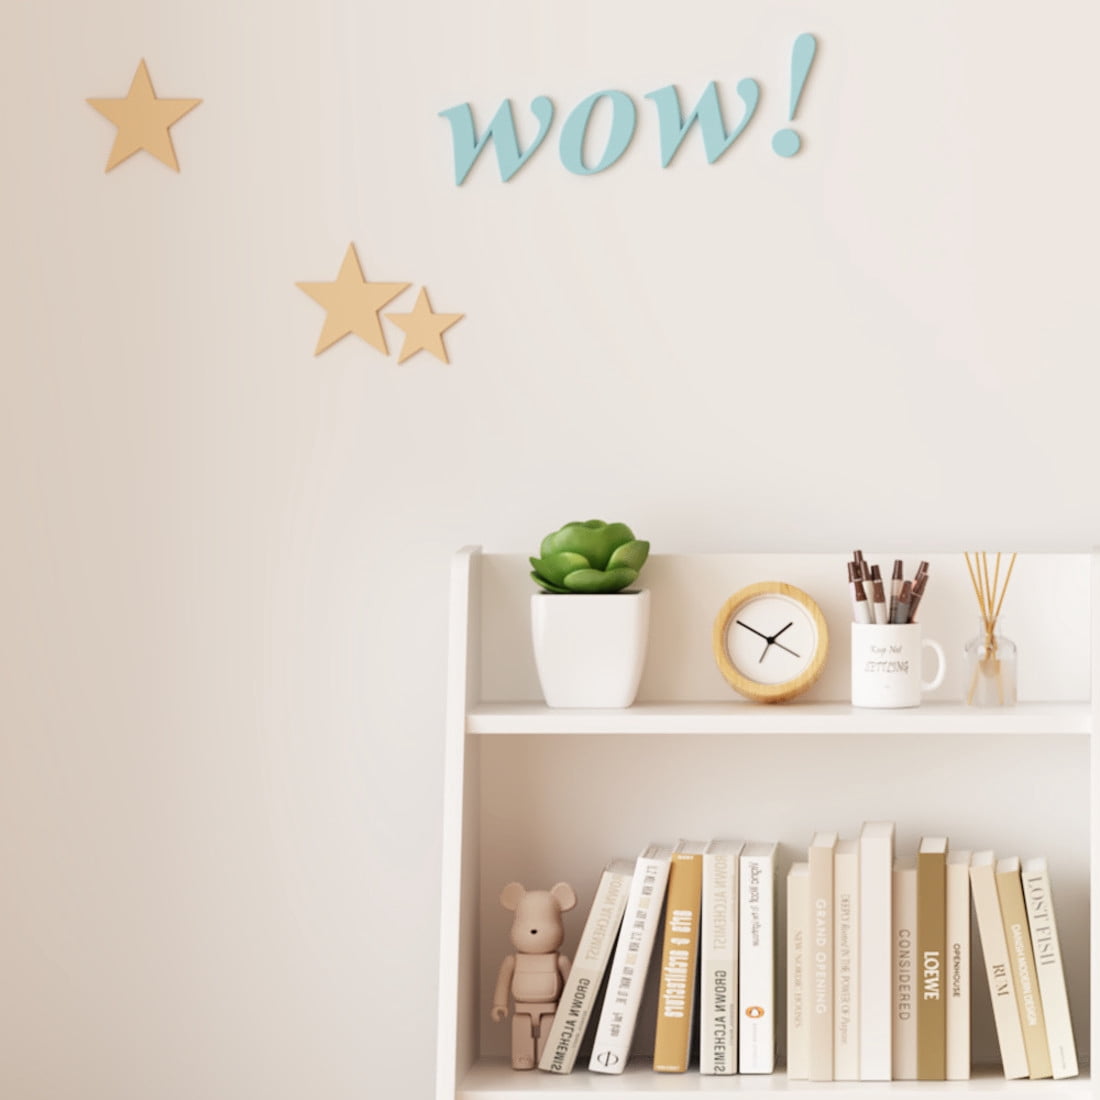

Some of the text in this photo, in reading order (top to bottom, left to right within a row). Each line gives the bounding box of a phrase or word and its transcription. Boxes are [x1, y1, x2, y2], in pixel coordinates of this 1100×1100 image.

[437, 32, 817, 187] wow!
[816, 898, 827, 1015] GRAND OPENING
[1027, 876, 1056, 966] LOST FISH
[898, 929, 911, 1021] CONSIDERED
[923, 951, 940, 1001] LOEWE
[952, 943, 961, 998] OPENHOUSE
